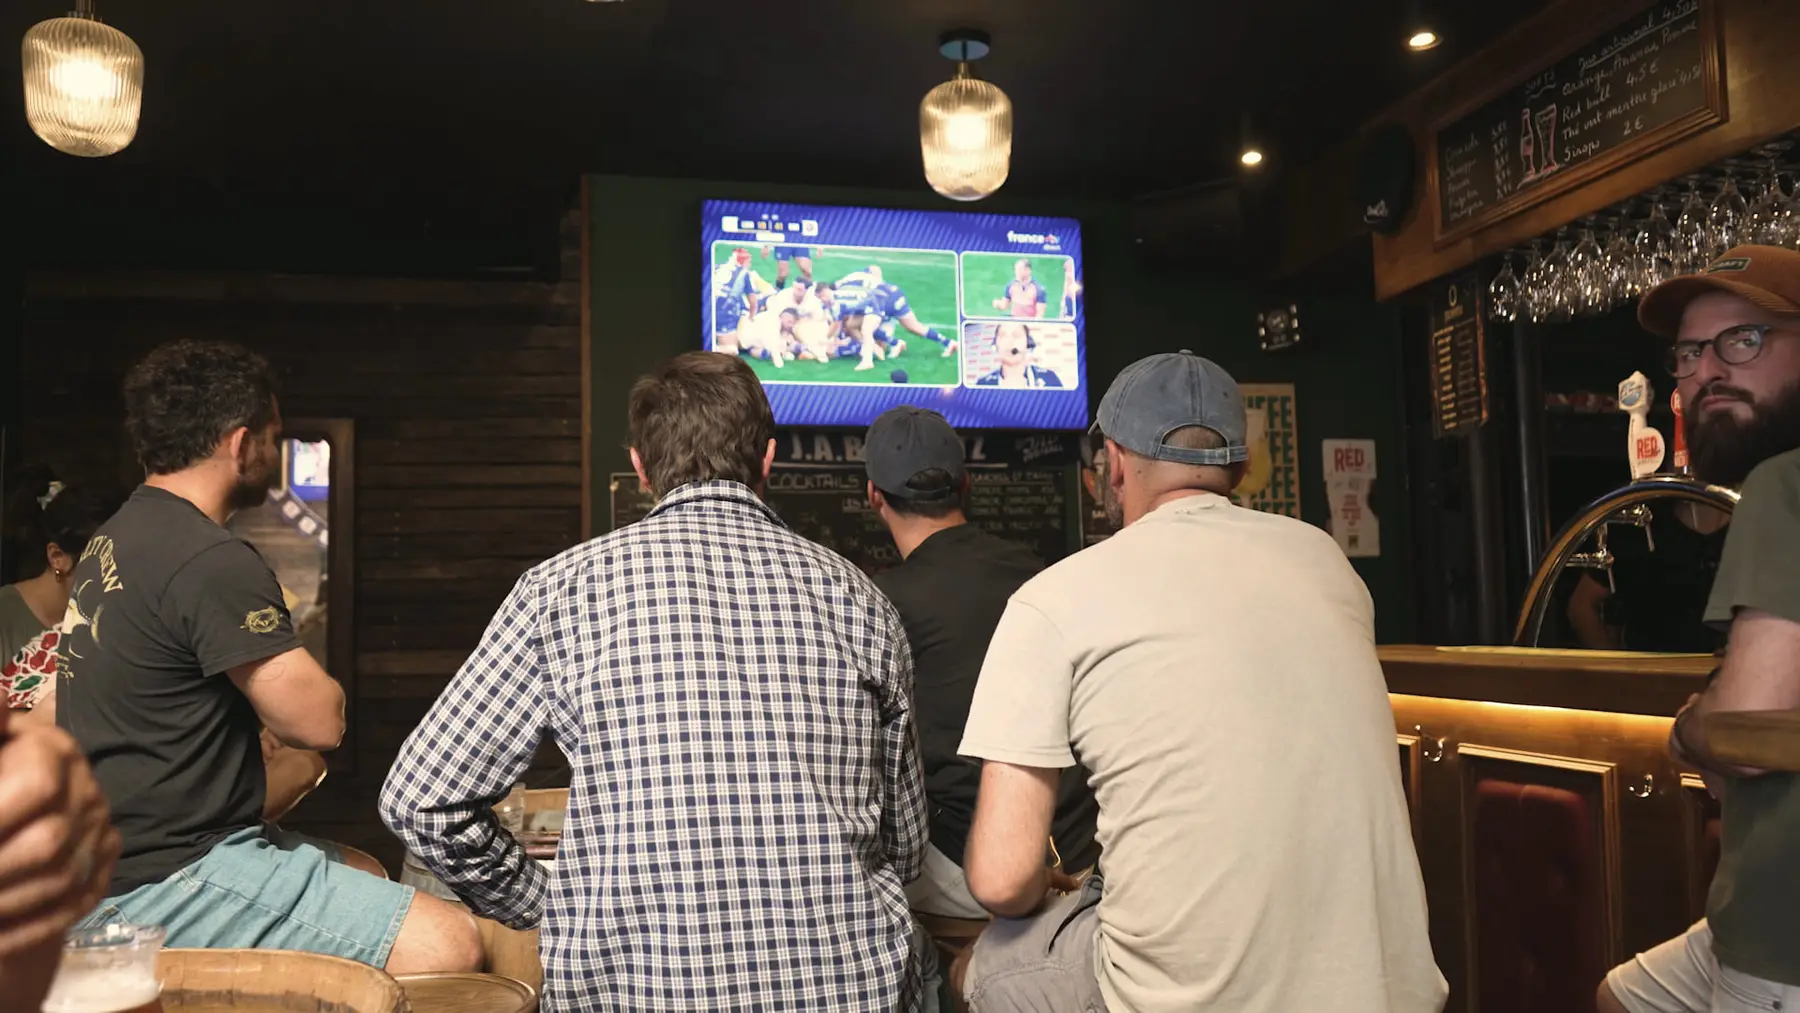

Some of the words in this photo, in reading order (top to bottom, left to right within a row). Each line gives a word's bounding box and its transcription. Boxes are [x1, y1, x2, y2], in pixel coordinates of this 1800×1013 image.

[1562, 100, 1581, 122] Red
[1636, 436, 1659, 459] RED
[1334, 448, 1364, 472] RED
[767, 473, 860, 490] COCKTAILS
